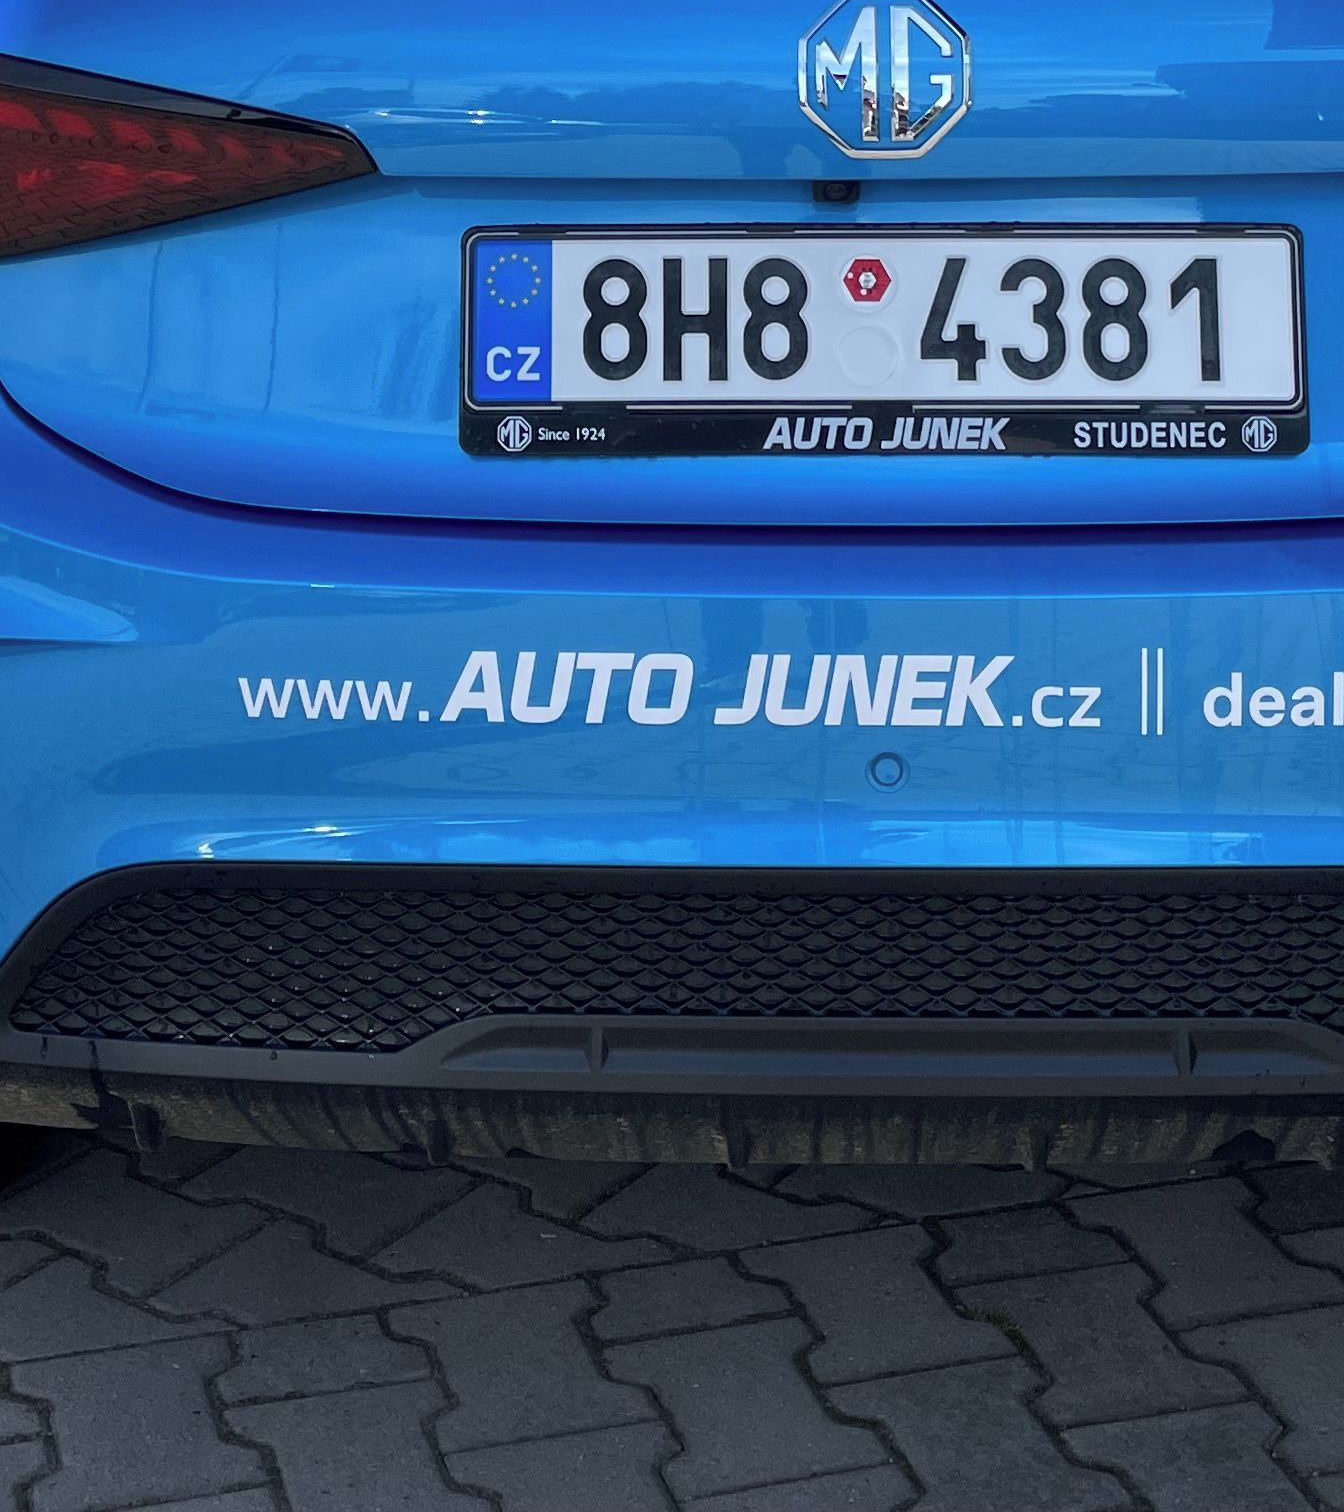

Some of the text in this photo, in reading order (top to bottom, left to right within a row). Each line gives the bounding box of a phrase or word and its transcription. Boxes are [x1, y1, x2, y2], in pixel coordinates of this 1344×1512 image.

[811, 1, 958, 146] MG
[581, 256, 1223, 384] 8H8 4381
[486, 345, 542, 382] CZ
[537, 426, 570, 441] Since
[574, 426, 606, 442] 1924
[762, 417, 1010, 451] AUTO JUNEK
[1073, 420, 1227, 450] STUDENEC
